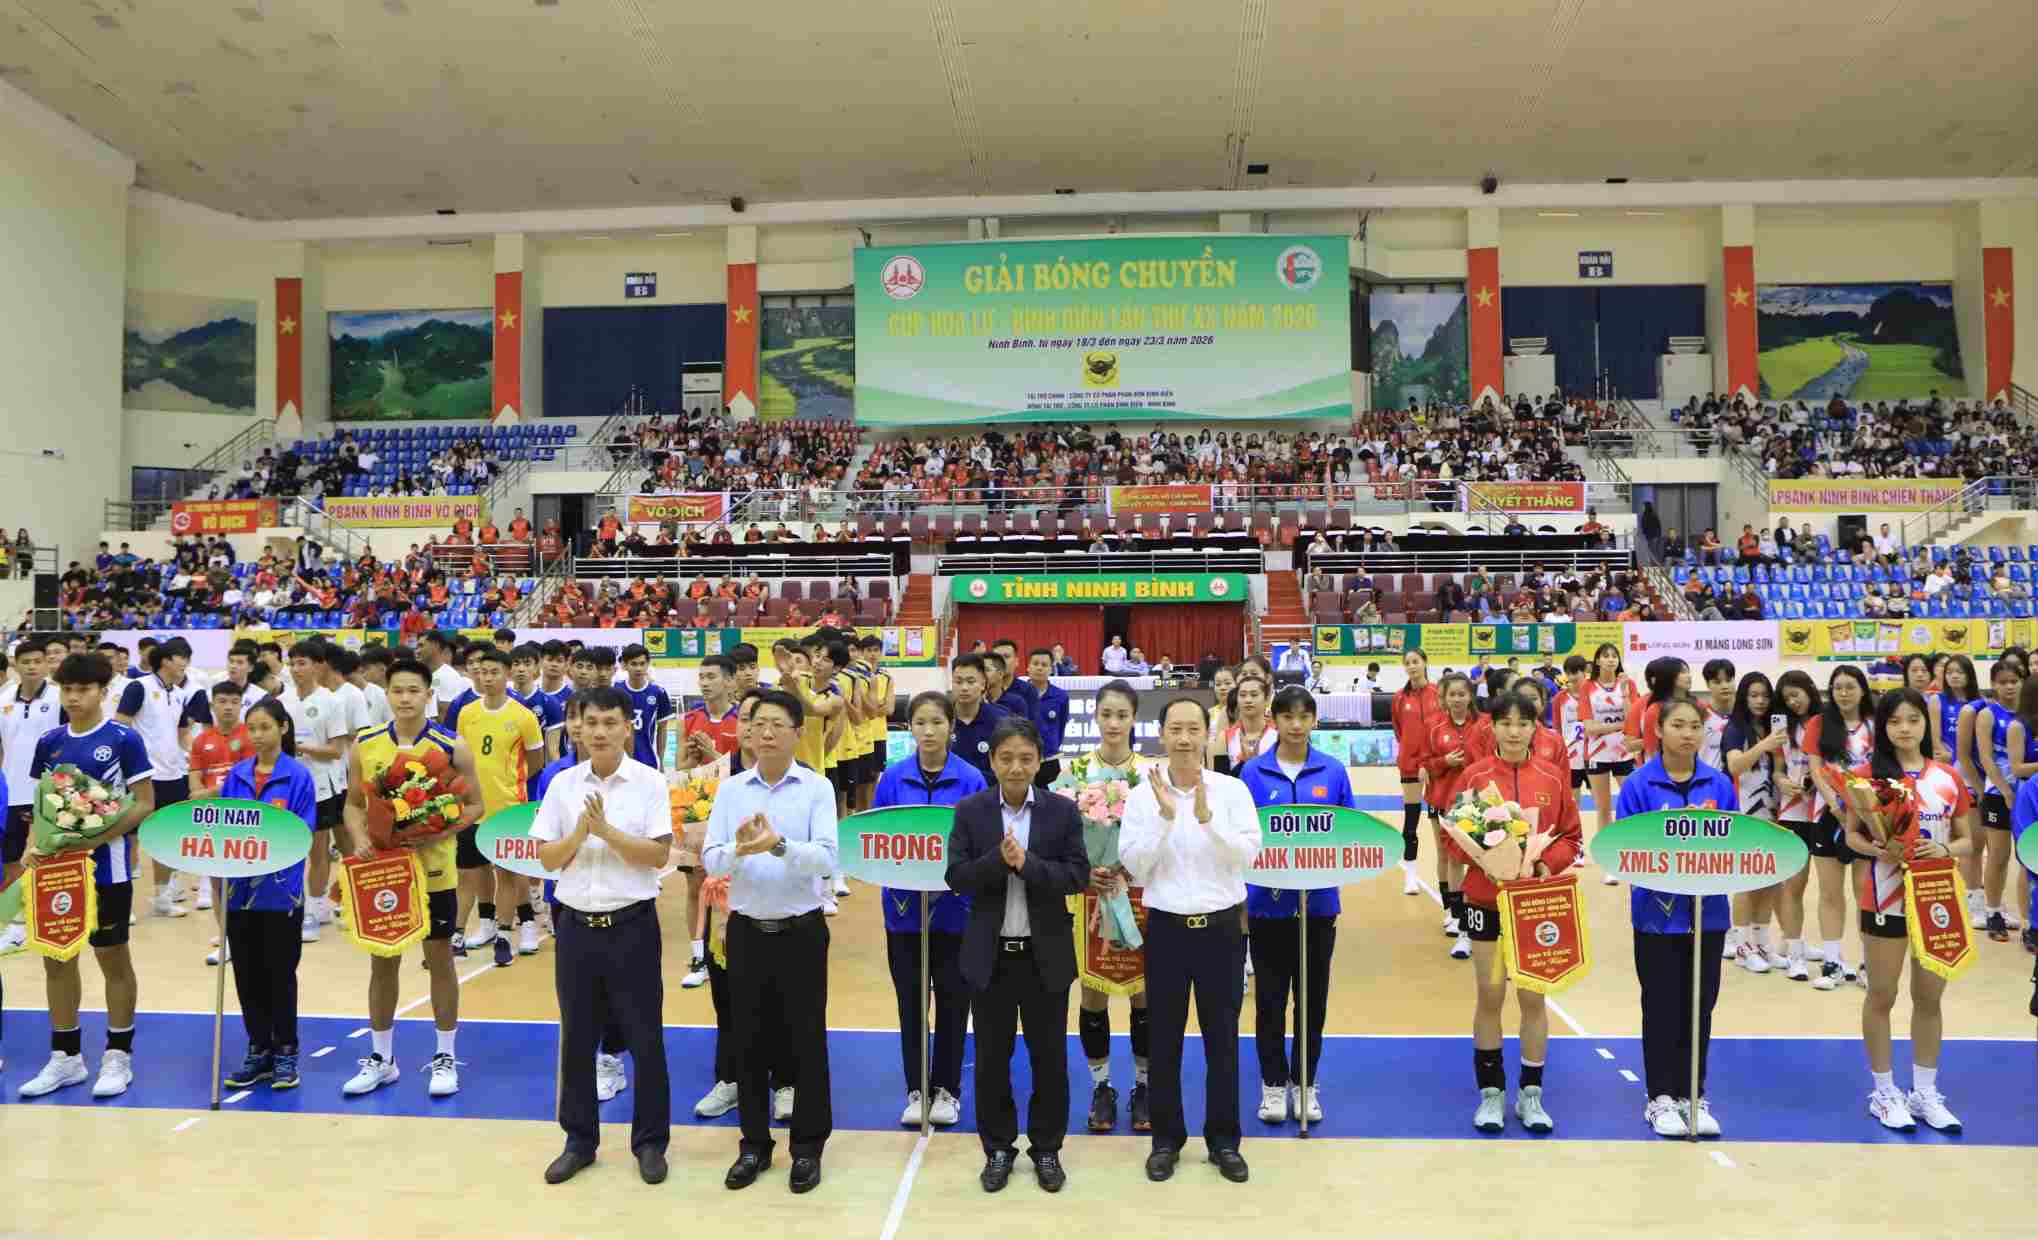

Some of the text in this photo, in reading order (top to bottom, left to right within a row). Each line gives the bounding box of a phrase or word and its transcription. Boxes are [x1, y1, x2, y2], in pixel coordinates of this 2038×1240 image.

[964, 246, 1238, 295] GIẢI BÓNG CHUYỀN
[328, 504, 368, 520] PBANK
[1001, 575, 1195, 598] TỈNH NINH BÌNH
[1732, 639, 1754, 650] LONG
[481, 735, 493, 756] 8
[193, 805, 260, 827] ĐỘI NAM
[1270, 811, 1334, 837] ĐỘI NỮ
[1665, 815, 1732, 840] ĐỘI NỮ
[181, 833, 268, 864] HÀ NỘI
[860, 833, 944, 866] TRỌNG
[1253, 842, 1384, 869] ANK NINH BÌNH
[1618, 848, 1776, 875] XMLS THANH HÓA
[1467, 908, 1484, 932] 89
